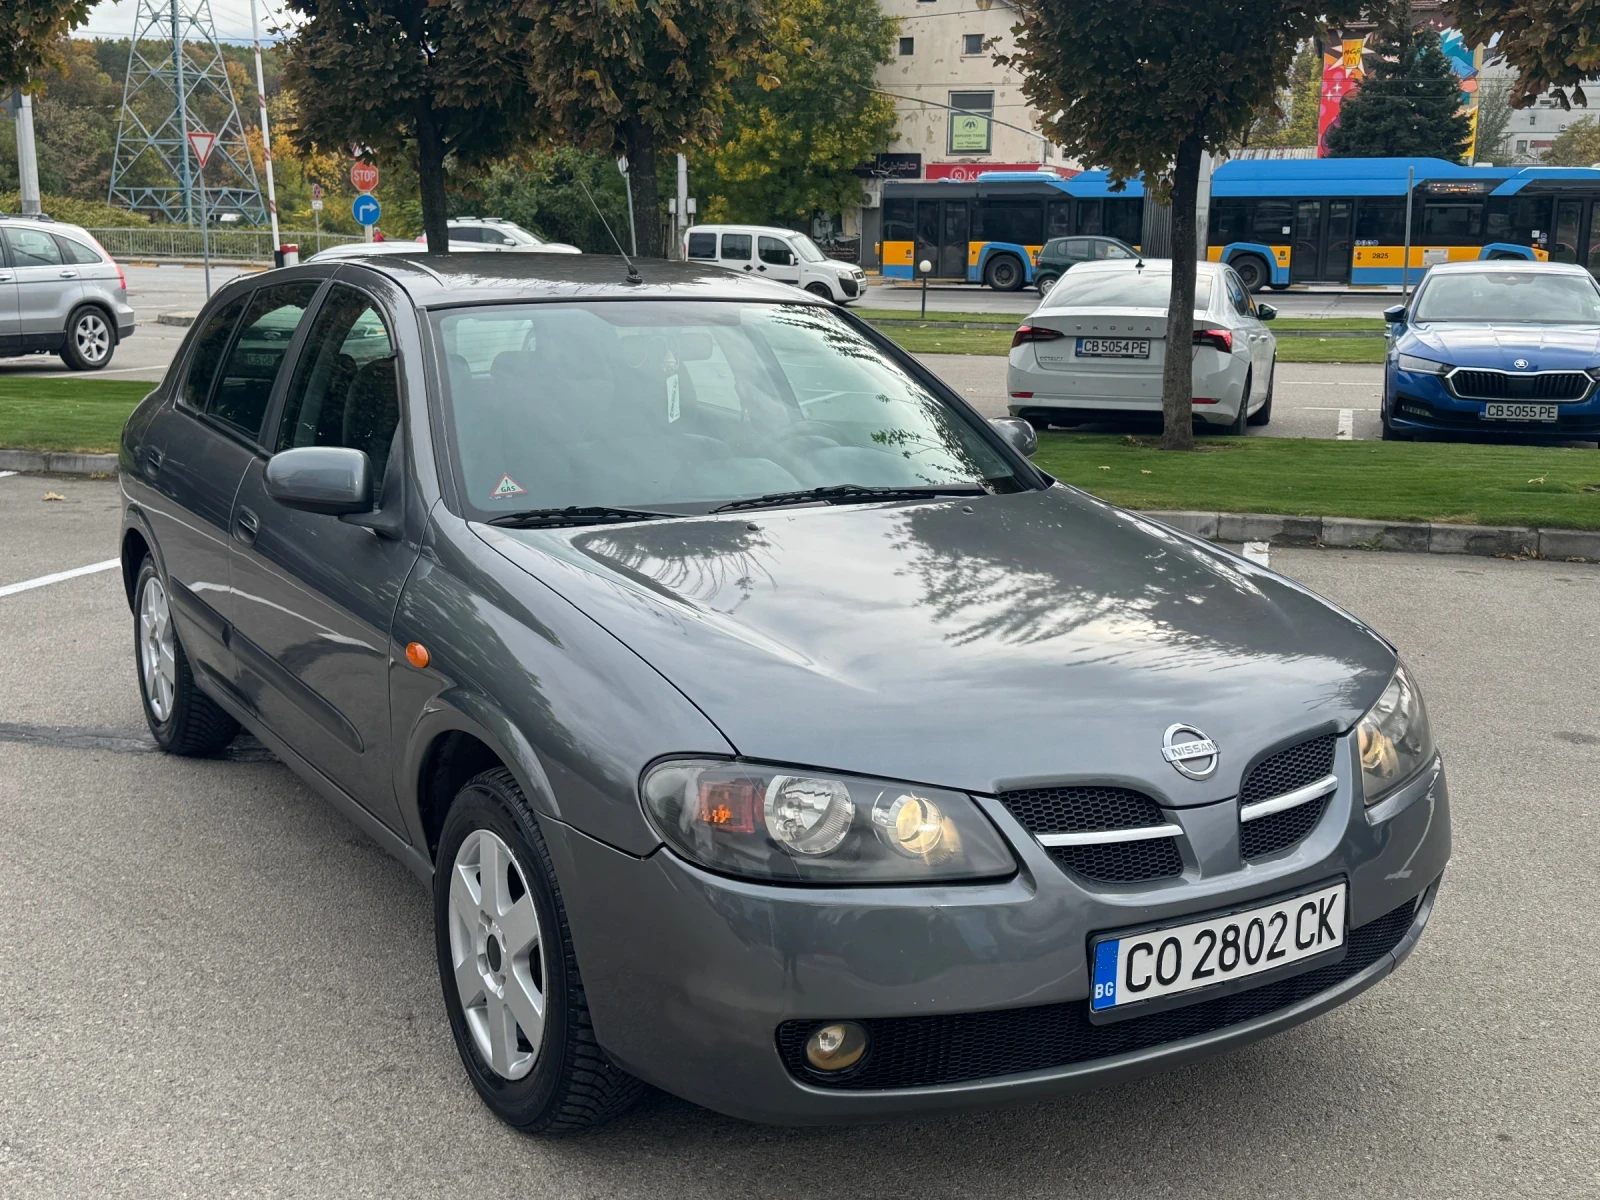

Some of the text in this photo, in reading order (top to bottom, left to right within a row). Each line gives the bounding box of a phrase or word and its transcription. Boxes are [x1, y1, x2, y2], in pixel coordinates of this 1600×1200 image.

[354, 170, 376, 182] STOP
[1084, 340, 1147, 354] CB 5054 PE
[1488, 405, 1504, 417] CB
[1506, 405, 1537, 418] 5055
[1539, 406, 1556, 418] PE
[1171, 742, 1217, 758] NISSAN
[1125, 893, 1338, 993] CO 2802 CK
[1095, 981, 1114, 999] BG
